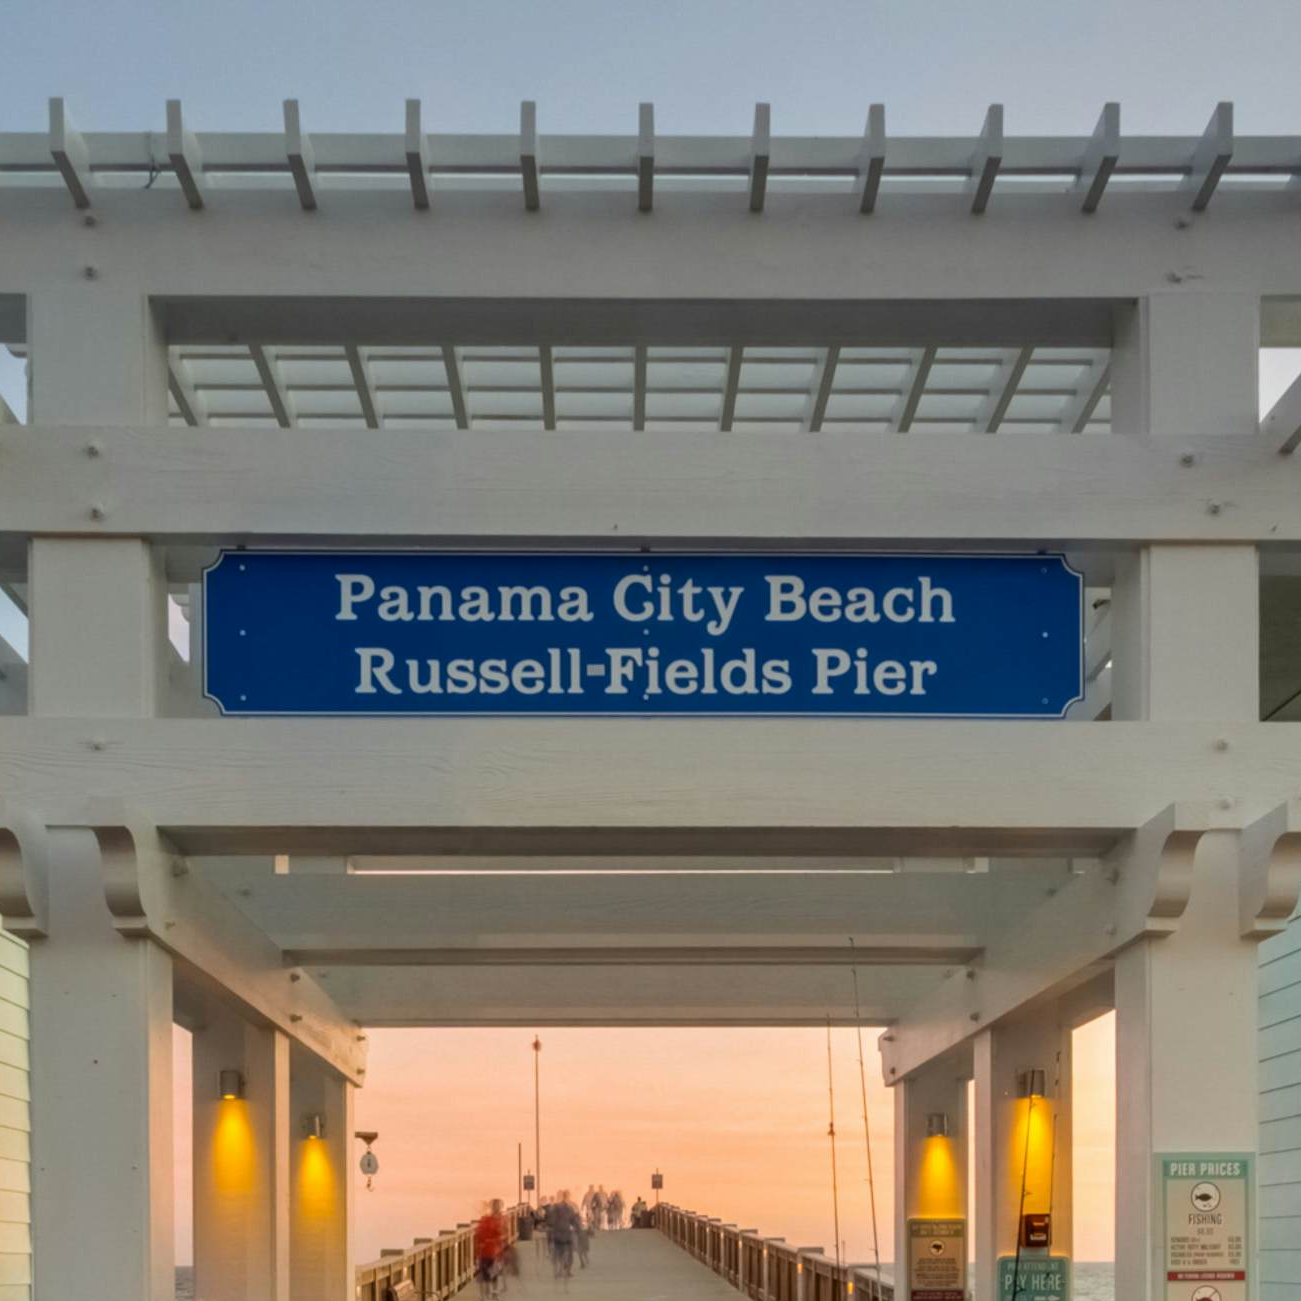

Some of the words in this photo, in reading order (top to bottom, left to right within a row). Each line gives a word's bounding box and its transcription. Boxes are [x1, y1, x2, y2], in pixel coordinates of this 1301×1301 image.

[335, 573, 593, 623] Panama
[612, 573, 744, 635] City
[764, 573, 956, 623] Beach
[354, 648, 792, 696] Russell-Fields
[811, 648, 937, 696] Pier
[1170, 1162, 1196, 1176] PIER
[1200, 1162, 1240, 1176] PRICES
[1188, 1213, 1222, 1225] FISHING
[1031, 1274, 1061, 1291] HERE
